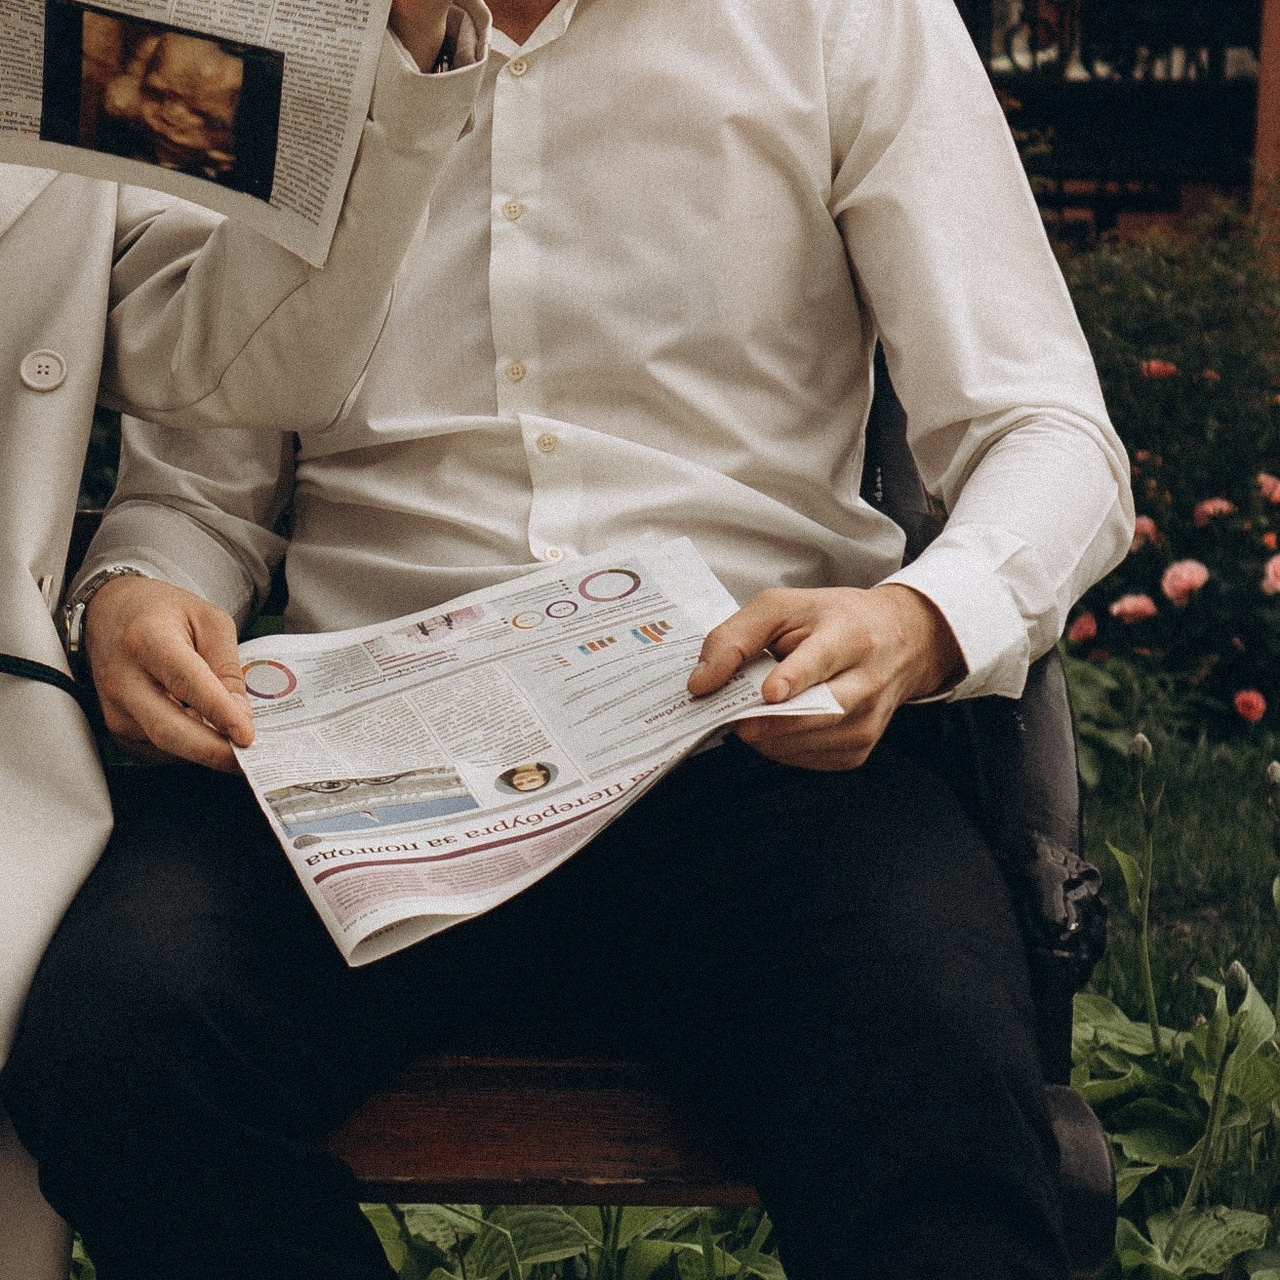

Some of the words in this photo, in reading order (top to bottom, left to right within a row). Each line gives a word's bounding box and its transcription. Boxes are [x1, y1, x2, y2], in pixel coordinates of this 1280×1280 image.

[464, 783, 626, 840] Петербурга
[304, 841, 421, 868] полгода
[426, 835, 460, 849] за
